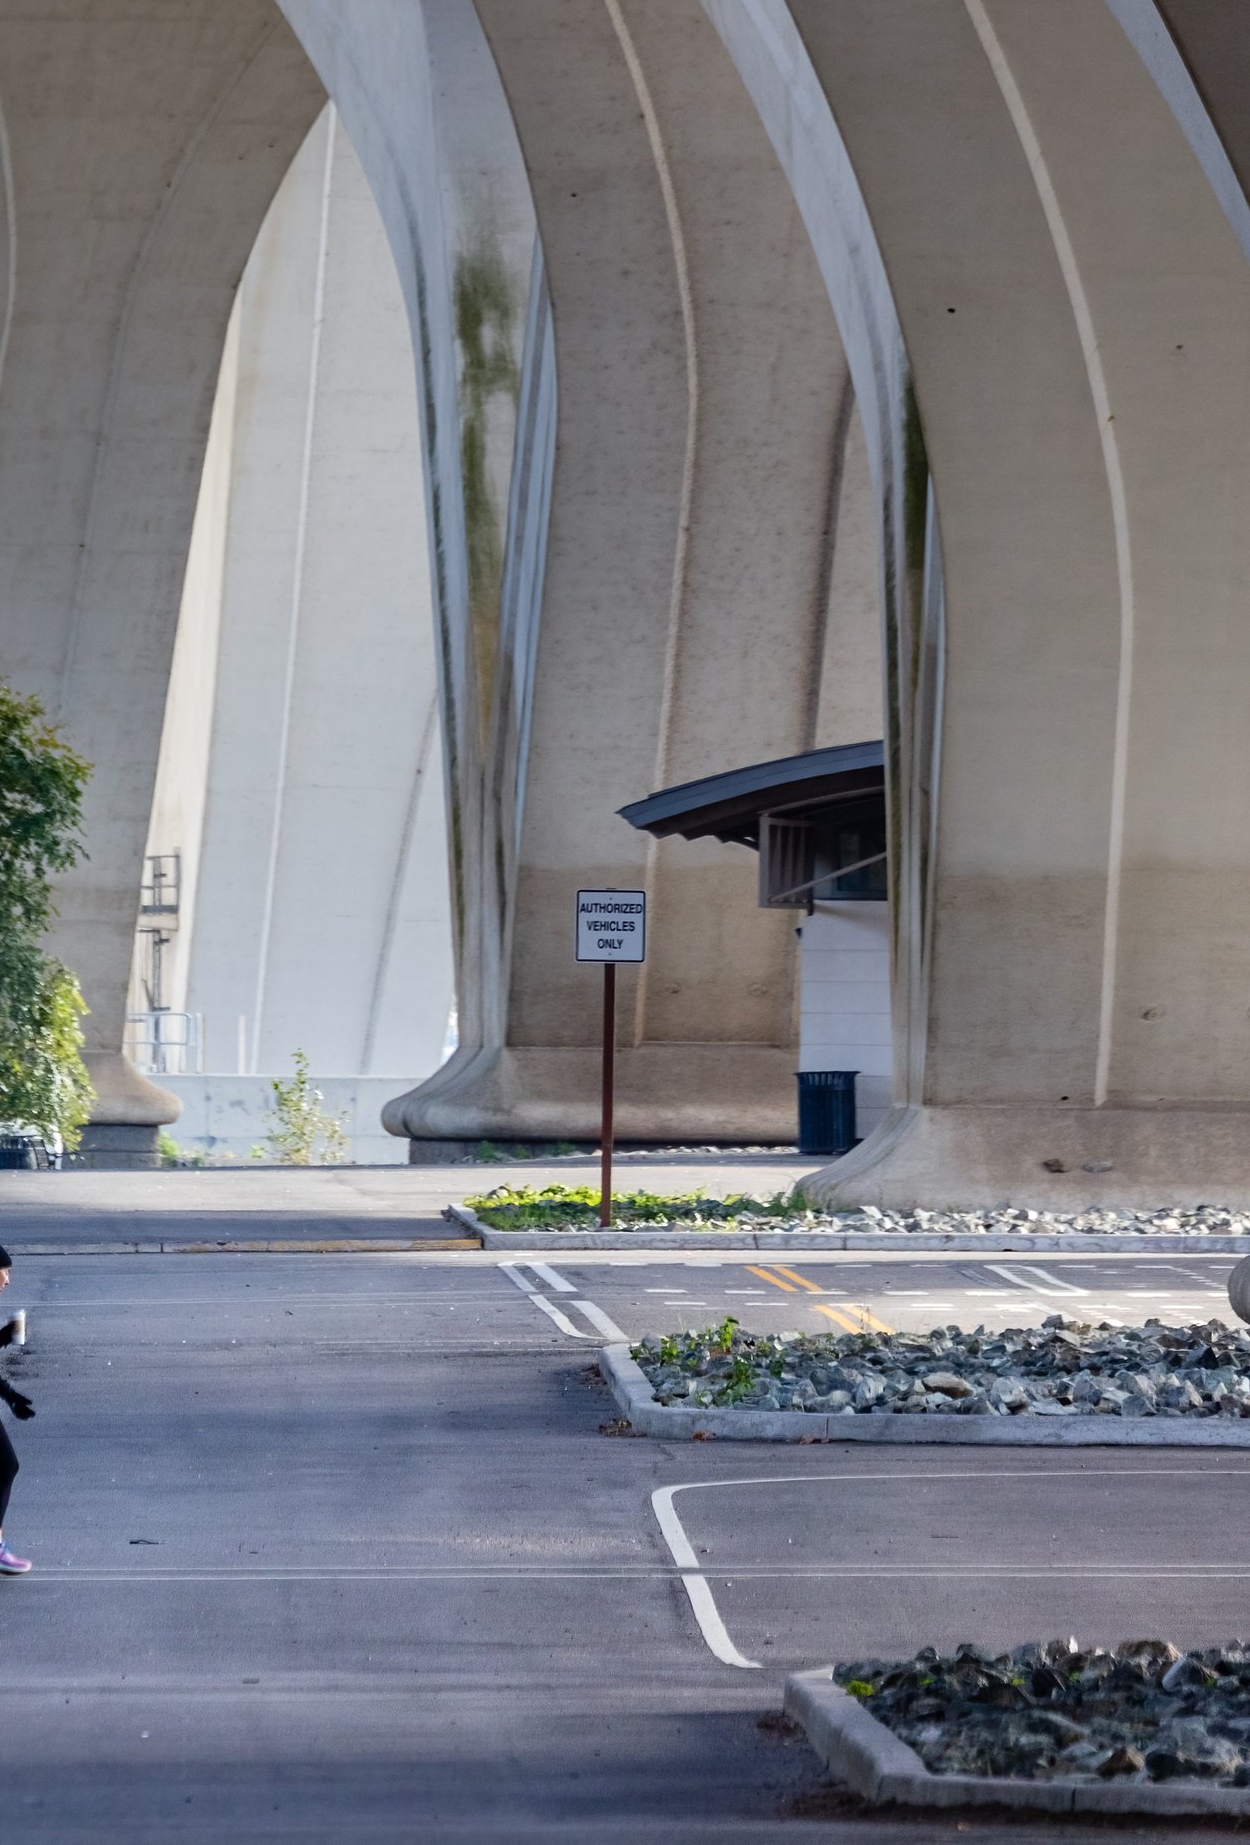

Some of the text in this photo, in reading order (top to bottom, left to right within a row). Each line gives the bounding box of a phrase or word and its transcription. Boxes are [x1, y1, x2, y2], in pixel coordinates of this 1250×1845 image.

[579, 902, 643, 914] AUTHORIZED
[586, 920, 635, 932] VEHICLES
[597, 938, 624, 949] ONLY
